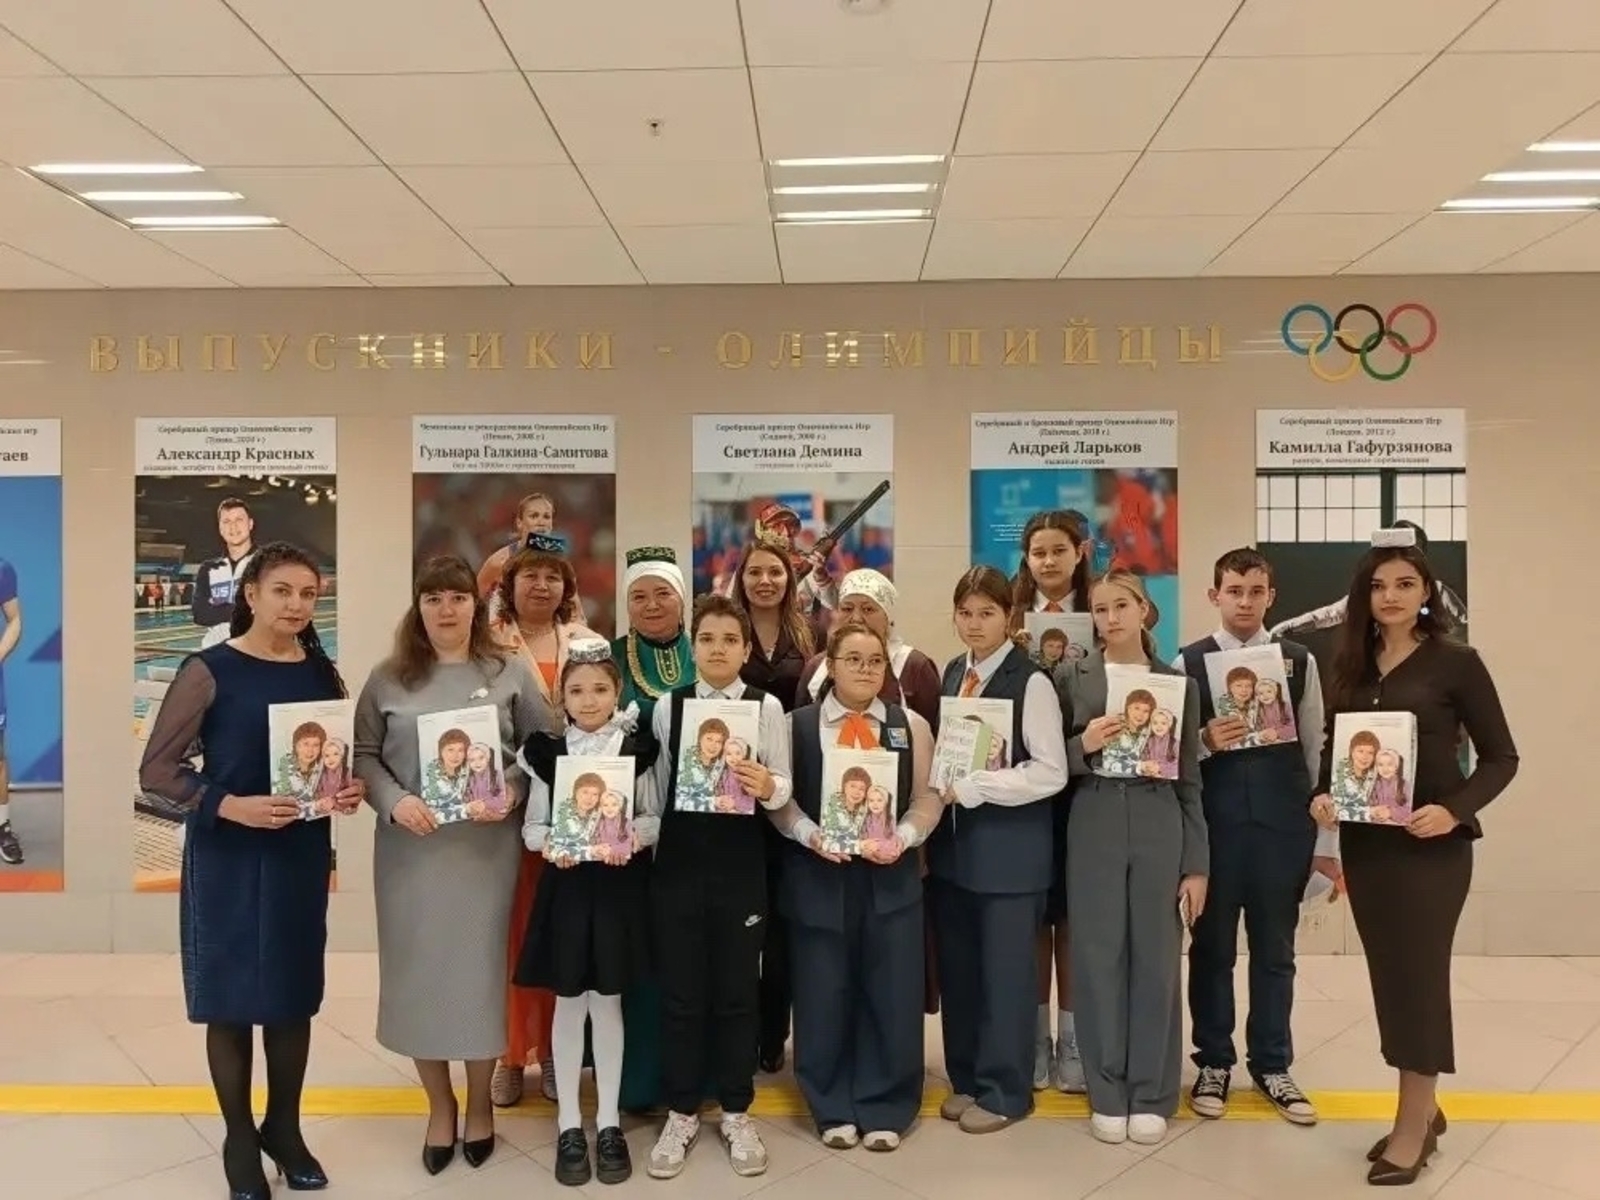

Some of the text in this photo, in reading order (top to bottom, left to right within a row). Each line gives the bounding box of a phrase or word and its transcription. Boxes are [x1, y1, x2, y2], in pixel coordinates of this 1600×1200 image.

[88, 331, 617, 373] ВЫПУСКНИКИ
[715, 317, 1223, 371] ОЛИМПИЙЦЫ
[156, 447, 315, 463] Александр Красных
[420, 444, 608, 461] Гульнара Галкина-Самитова
[723, 444, 862, 459] Светлана Демина
[1008, 440, 1142, 457] Андрей Ларьков
[1269, 439, 1453, 457] Камилла Гафурзянова
[0, 452, 28, 462] аев
